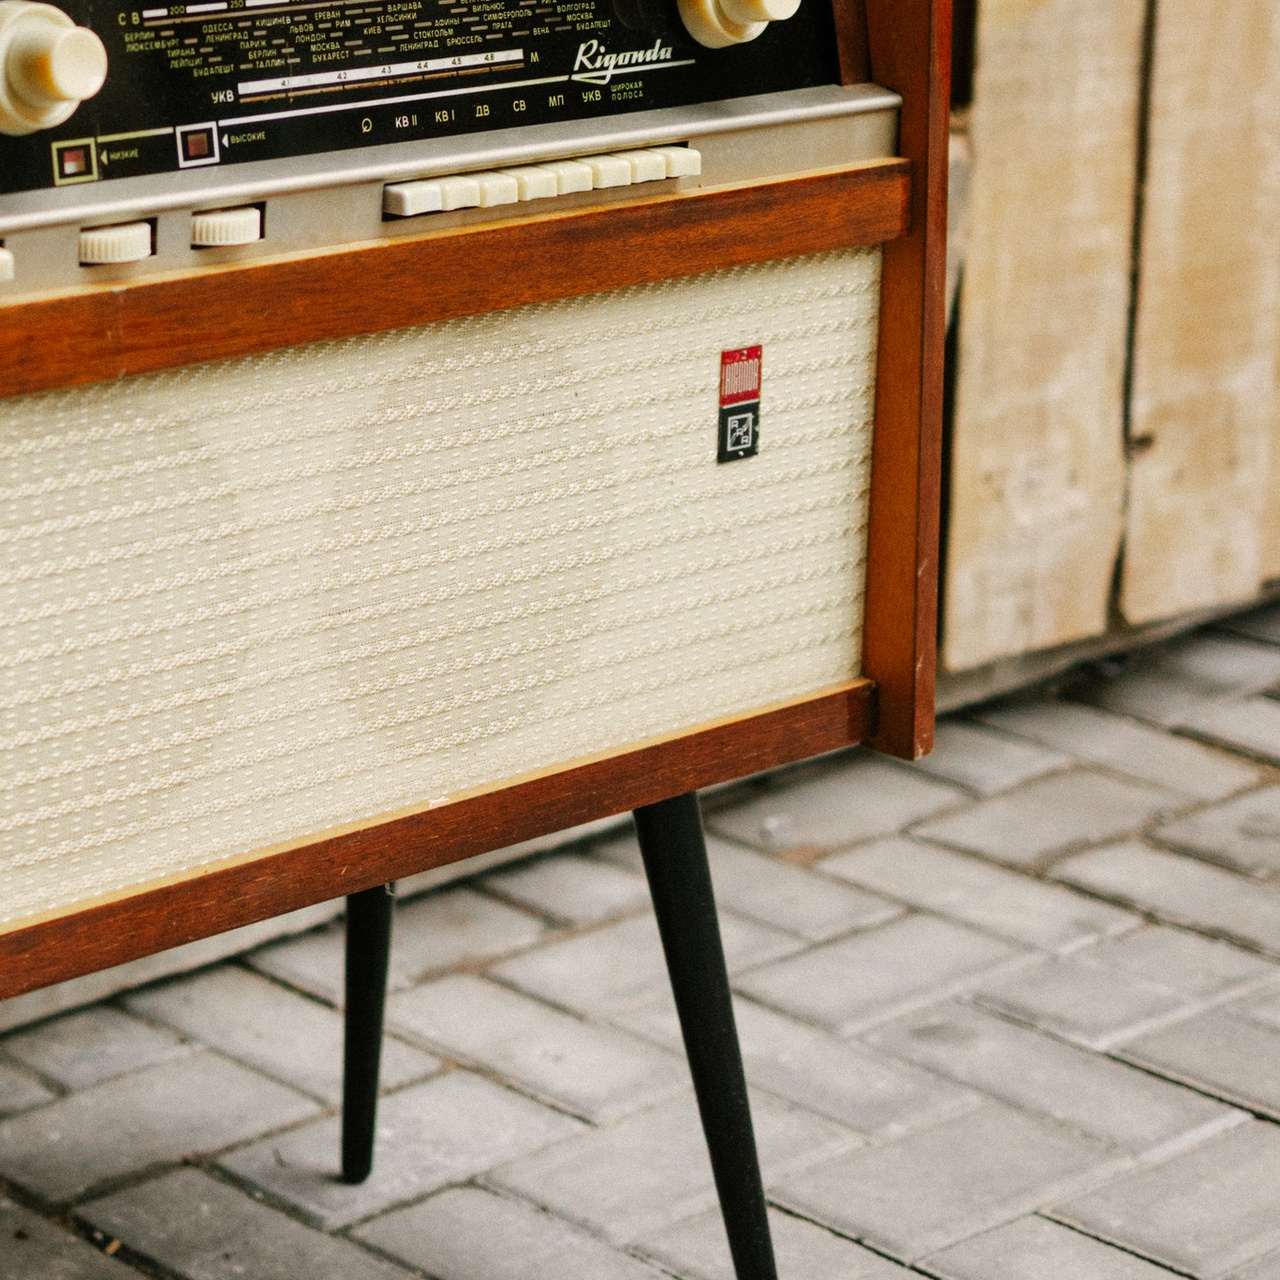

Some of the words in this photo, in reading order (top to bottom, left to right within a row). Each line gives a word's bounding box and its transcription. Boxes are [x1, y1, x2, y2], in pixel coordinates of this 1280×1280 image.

[124, 31, 155, 42] БЕРЛИН
[202, 23, 234, 34] ОДЕССА
[256, 15, 291, 27] КИШИНЕВ
[314, 10, 341, 20] ЕРЕВАН
[387, 1, 423, 13] ВАРШАВА
[126, 38, 180, 52] ЛЮКСЕМБУРГ
[205, 31, 249, 44] ЛЕНИНГРАД
[289, 24, 314, 34] ЛЬВОВ
[335, 19, 351, 28] РИМ
[376, 12, 418, 24] ХЕЛЬСИНКИ
[472, 2, 505, 13] ВИЛЬНЮС
[170, 5, 185, 15] 200
[230, 0, 244, 9] 250
[167, 47, 196, 58] ТИРАНА
[239, 39, 267, 50] ПАРИЖ
[295, 32, 326, 44] ЛОНДОН
[363, 25, 382, 35] КИЕВ
[434, 17, 460, 27] АФИНЫ
[483, 9, 532, 21] СИМФЕРОПОЛЬ
[557, 2, 595, 13] ВОЛГОГРАД
[170, 57, 203, 69] ЛЕЙПЦИГ
[248, 49, 277, 60] БЕРЛИН
[310, 41, 341, 52] МОСКВА
[413, 28, 454, 40] СТОКГОЛЬМ
[492, 21, 513, 30] ПРАГА
[566, 12, 594, 21] МОСКВА
[193, 64, 234, 77] БУДАПЕШТ
[256, 58, 285, 69] ТАЛЛИН
[312, 51, 350, 63] БУХАРЕСТ
[400, 39, 439, 52] ЛЕНИНГРАД
[446, 35, 483, 47] БРЮССЕЛЬ
[533, 27, 550, 36] ВЕНА
[576, 19, 611, 31] БУДАПЕШТ
[574, 38, 673, 85] Rigonda
[211, 89, 234, 104] УКВ
[610, 81, 643, 92] ШИРОКАЯ
[611, 90, 644, 101] ПОЛОСА
[395, 116, 409, 128] КВ
[435, 110, 449, 123] КВ
[475, 105, 490, 117] ДВ
[513, 100, 526, 112] СВ
[548, 94, 564, 107] МП
[582, 89, 602, 103] УКВ
[109, 148, 139, 161] НИЗКИЕ
[230, 131, 266, 144] ВЫСОКИЕ
